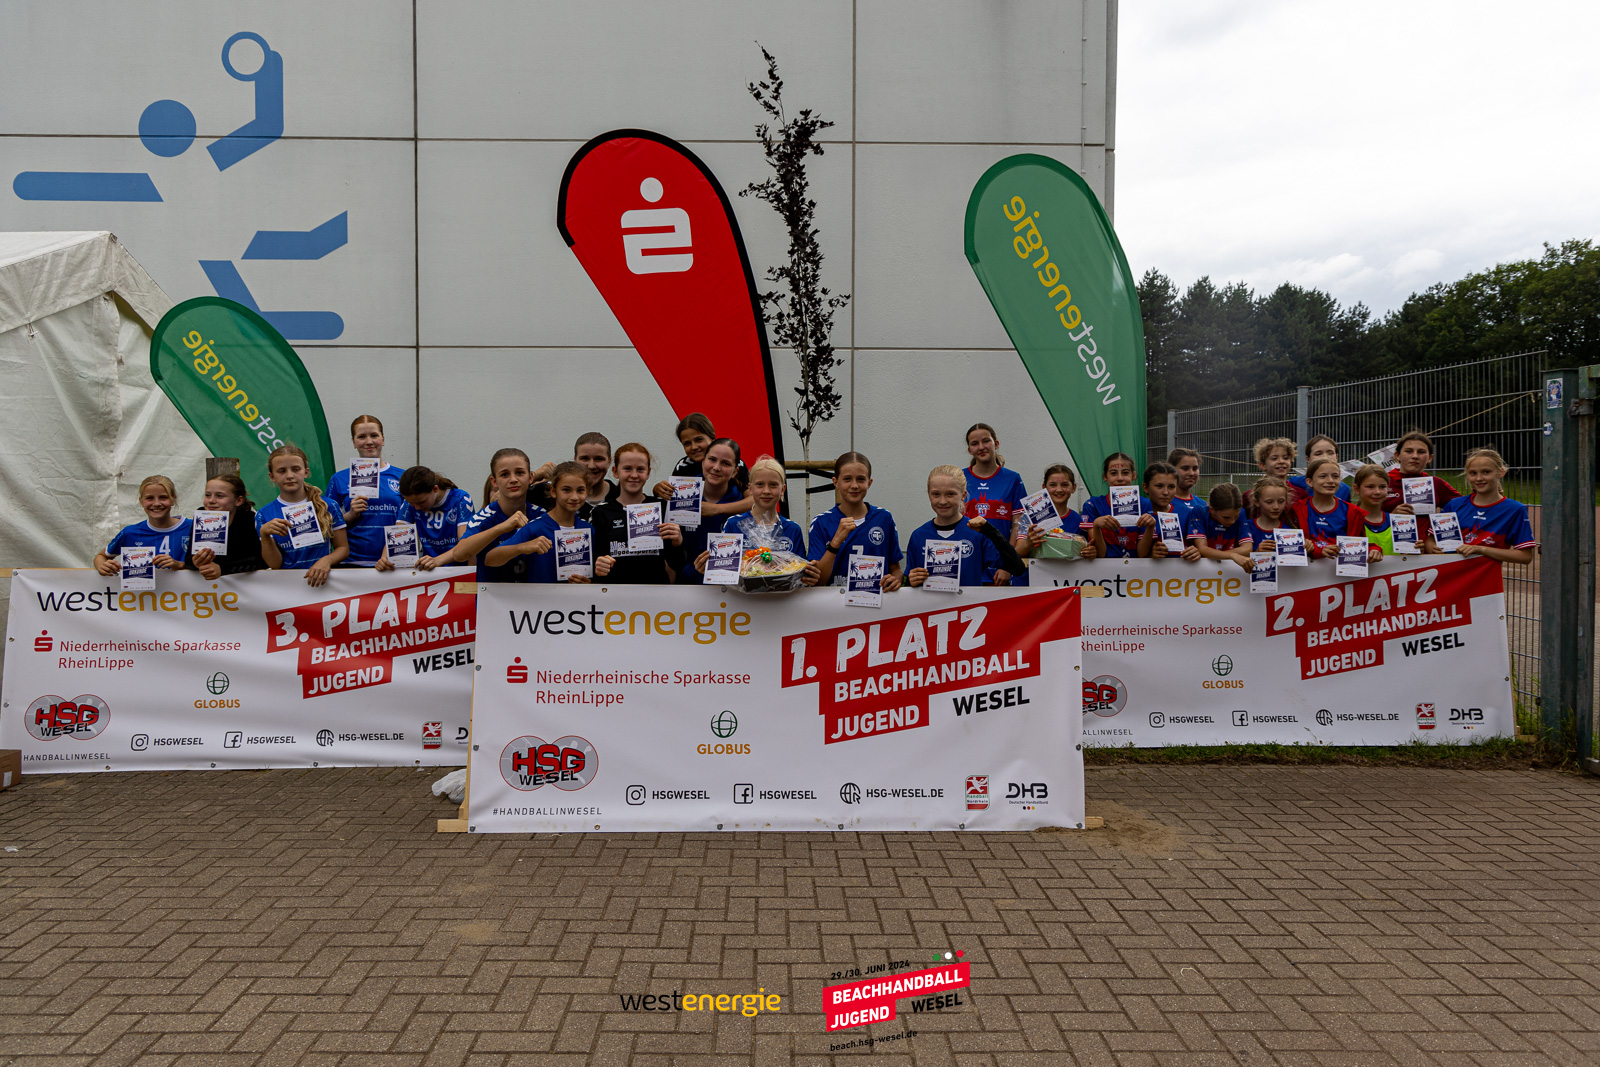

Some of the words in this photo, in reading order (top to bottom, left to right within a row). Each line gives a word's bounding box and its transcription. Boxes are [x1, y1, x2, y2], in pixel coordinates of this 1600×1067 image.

[366, 504, 398, 513] coaching
[424, 510, 444, 529] 29
[159, 535, 171, 555] 4
[37, 584, 240, 618] westenergie
[1272, 595, 1305, 631] 2.
[1318, 568, 1439, 623] PLATZ
[275, 611, 310, 647] 3.
[321, 581, 451, 639] PLATZ
[509, 602, 751, 645] westenergie
[1182, 624, 1243, 638] Sparkasse
[1306, 604, 1463, 648] BEACHHANDBALL
[59, 640, 170, 652] Niederrheinische
[173, 639, 241, 654] Sparkasse
[310, 619, 476, 664] BEACHHANDBALL
[790, 637, 818, 681] 1.
[836, 606, 988, 673] PLATZ
[1401, 632, 1465, 658] WESEL
[58, 657, 134, 671] RheinLippe
[412, 648, 475, 674] WESEL
[1306, 648, 1376, 677] JUGEND
[308, 665, 384, 695] JUGEND
[536, 670, 669, 684] Niederrheinische
[673, 670, 751, 687] Sparkasse
[834, 649, 1030, 703] BEACHHANDBALL
[1202, 680, 1244, 689] GLOBUS
[535, 690, 624, 707] RheinLippe
[952, 685, 1030, 716] WESEL
[1082, 682, 1117, 704] SG
[194, 699, 241, 709] GLOBUS
[1082, 701, 1112, 713] ESEL
[35, 701, 99, 728] HSG
[830, 704, 920, 739] JUGEND
[1169, 715, 1214, 724] HSGWESEL
[1252, 714, 1298, 724] HSGWESEL
[1336, 713, 1399, 722] HSG-WESEL.DE
[1448, 708, 1484, 721] DHB
[40, 722, 92, 737] WESEL
[338, 733, 404, 742] HSG-WESEL.DE
[153, 737, 204, 746] HSGWESEL
[246, 735, 296, 745] HSGWESEL
[23, 753, 111, 761] HANDBALLINWESEL
[696, 744, 751, 755] GLOBUS
[512, 744, 586, 776] HSG
[519, 770, 578, 787] WESEL
[652, 790, 710, 800] HSGWESEL
[759, 790, 817, 800] HSGWESEL
[866, 788, 944, 798] HSG-WESEL.DE
[1005, 782, 1048, 799] DHB
[492, 807, 602, 816] #HANDBALLINWESEL
